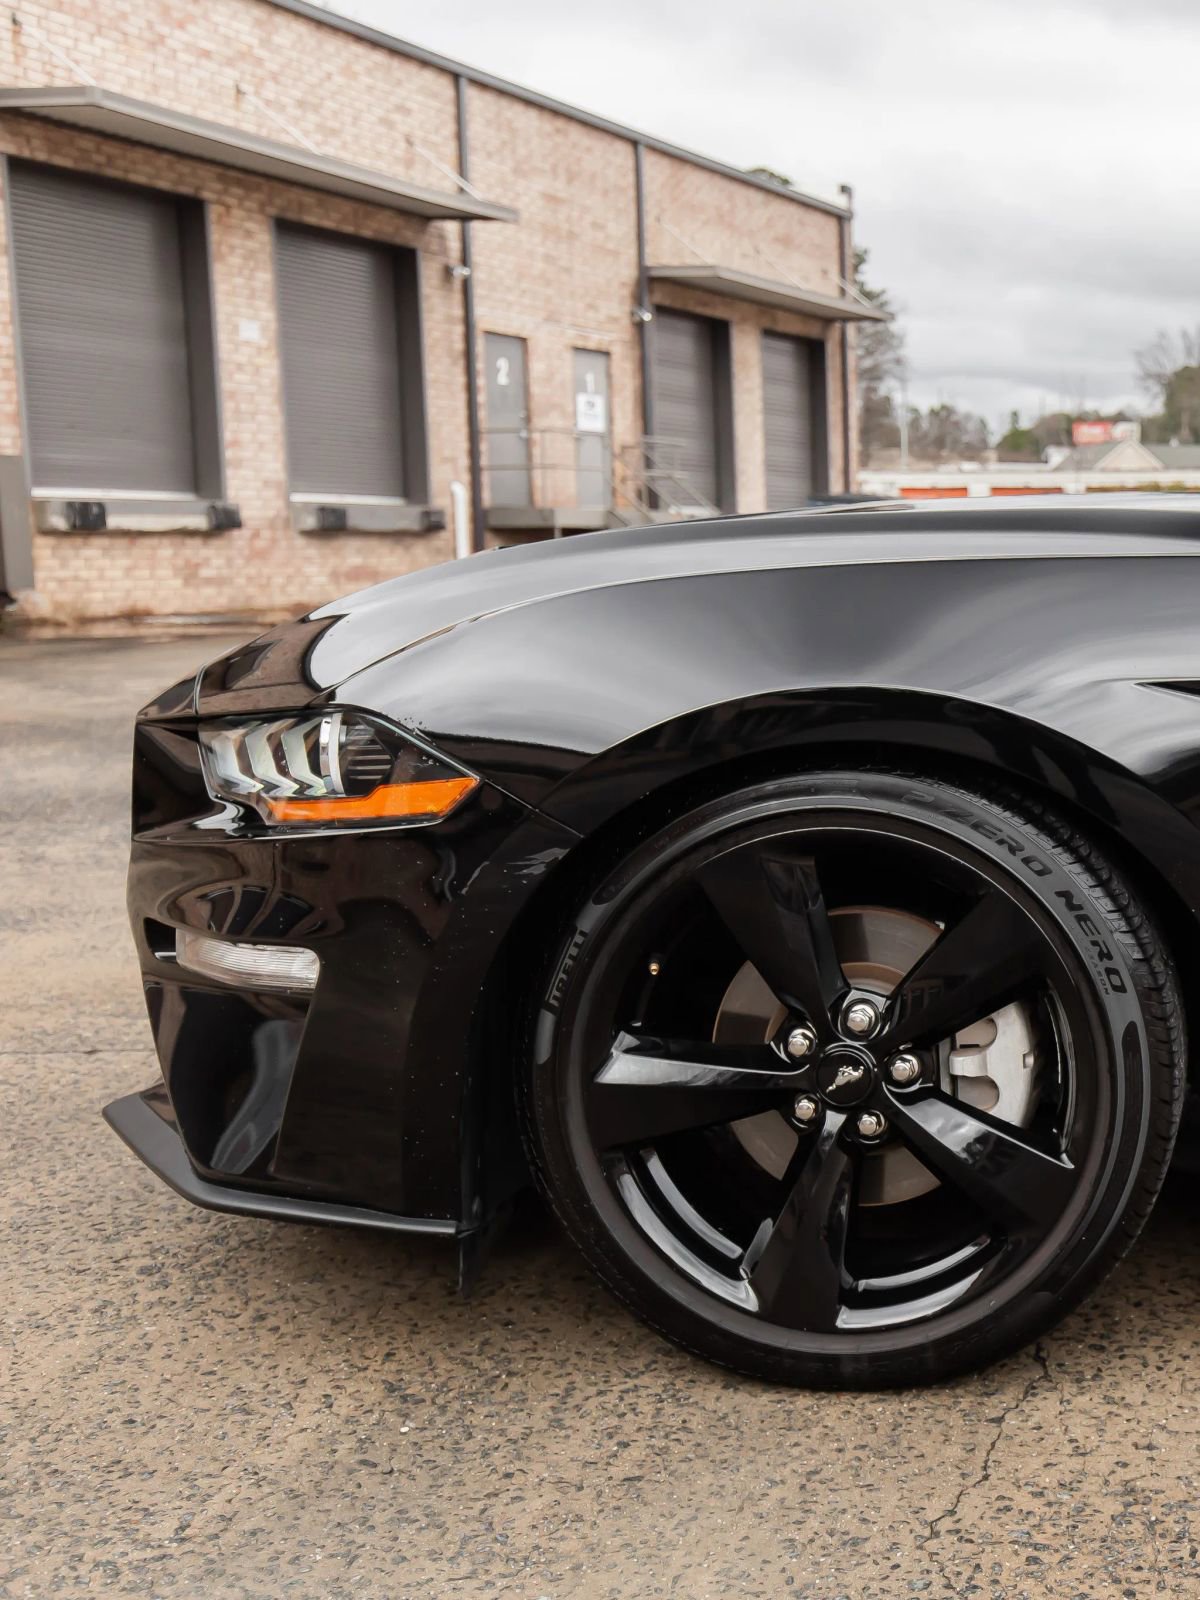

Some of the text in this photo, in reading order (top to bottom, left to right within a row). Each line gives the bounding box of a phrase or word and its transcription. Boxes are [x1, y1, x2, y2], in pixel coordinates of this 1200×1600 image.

[496, 357, 509, 386] 2
[584, 371, 595, 393] 1
[940, 809, 1053, 877] ZERO
[1054, 889, 1128, 994] NERO
